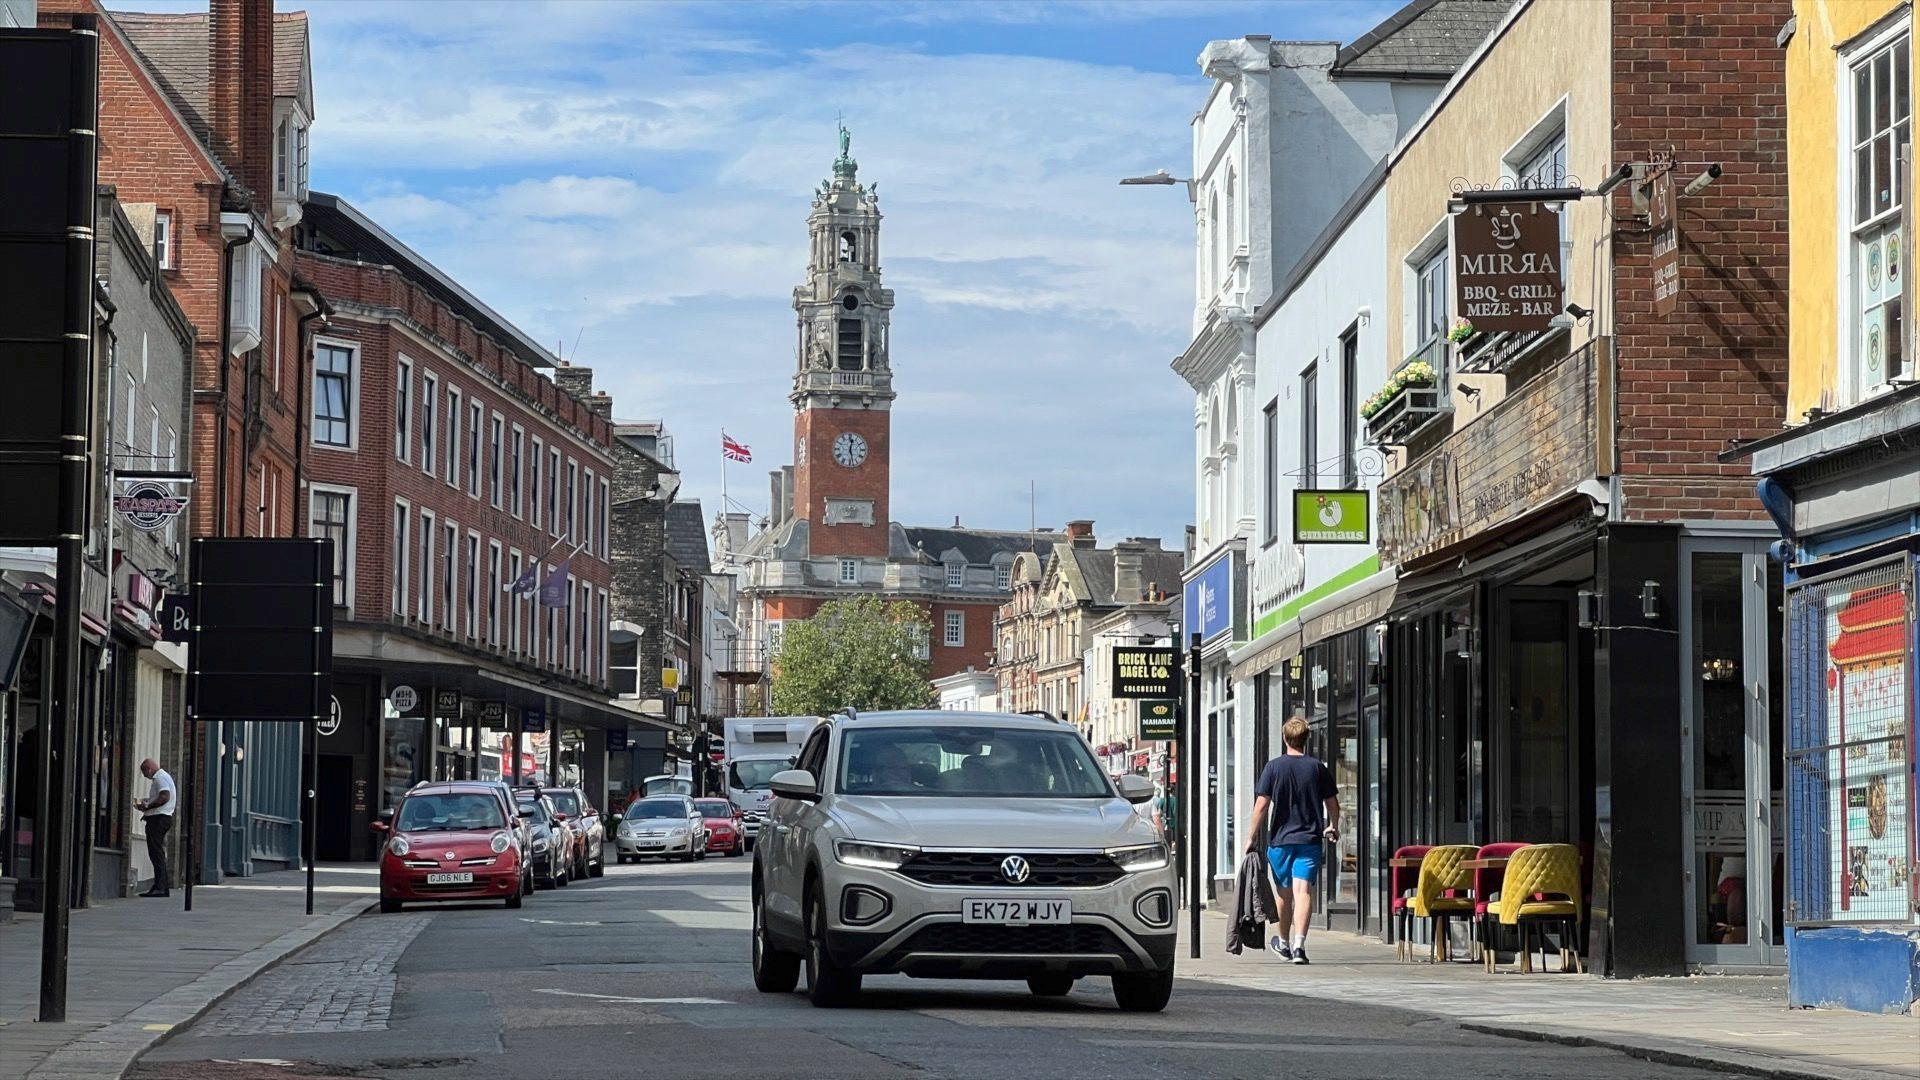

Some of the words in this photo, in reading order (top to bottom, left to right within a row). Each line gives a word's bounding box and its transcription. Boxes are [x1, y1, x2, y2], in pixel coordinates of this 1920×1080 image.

[1463, 285, 1501, 302] BBQ
[1508, 284, 1557, 299] GRILL
[1467, 302, 1512, 317] MEZE
[1521, 301, 1555, 316] BAR
[1299, 530, 1364, 541] emmaus
[1118, 652, 1147, 666] BRICK
[1149, 653, 1173, 666] LANE
[1120, 665, 1149, 678] BAGEL
[1123, 685, 1167, 693] COLCHESTER
[395, 699, 412, 707] PIZZA
[453, 873, 470, 882] NLE
[971, 902, 1021, 920] EK72
[1027, 902, 1063, 920] WJY
